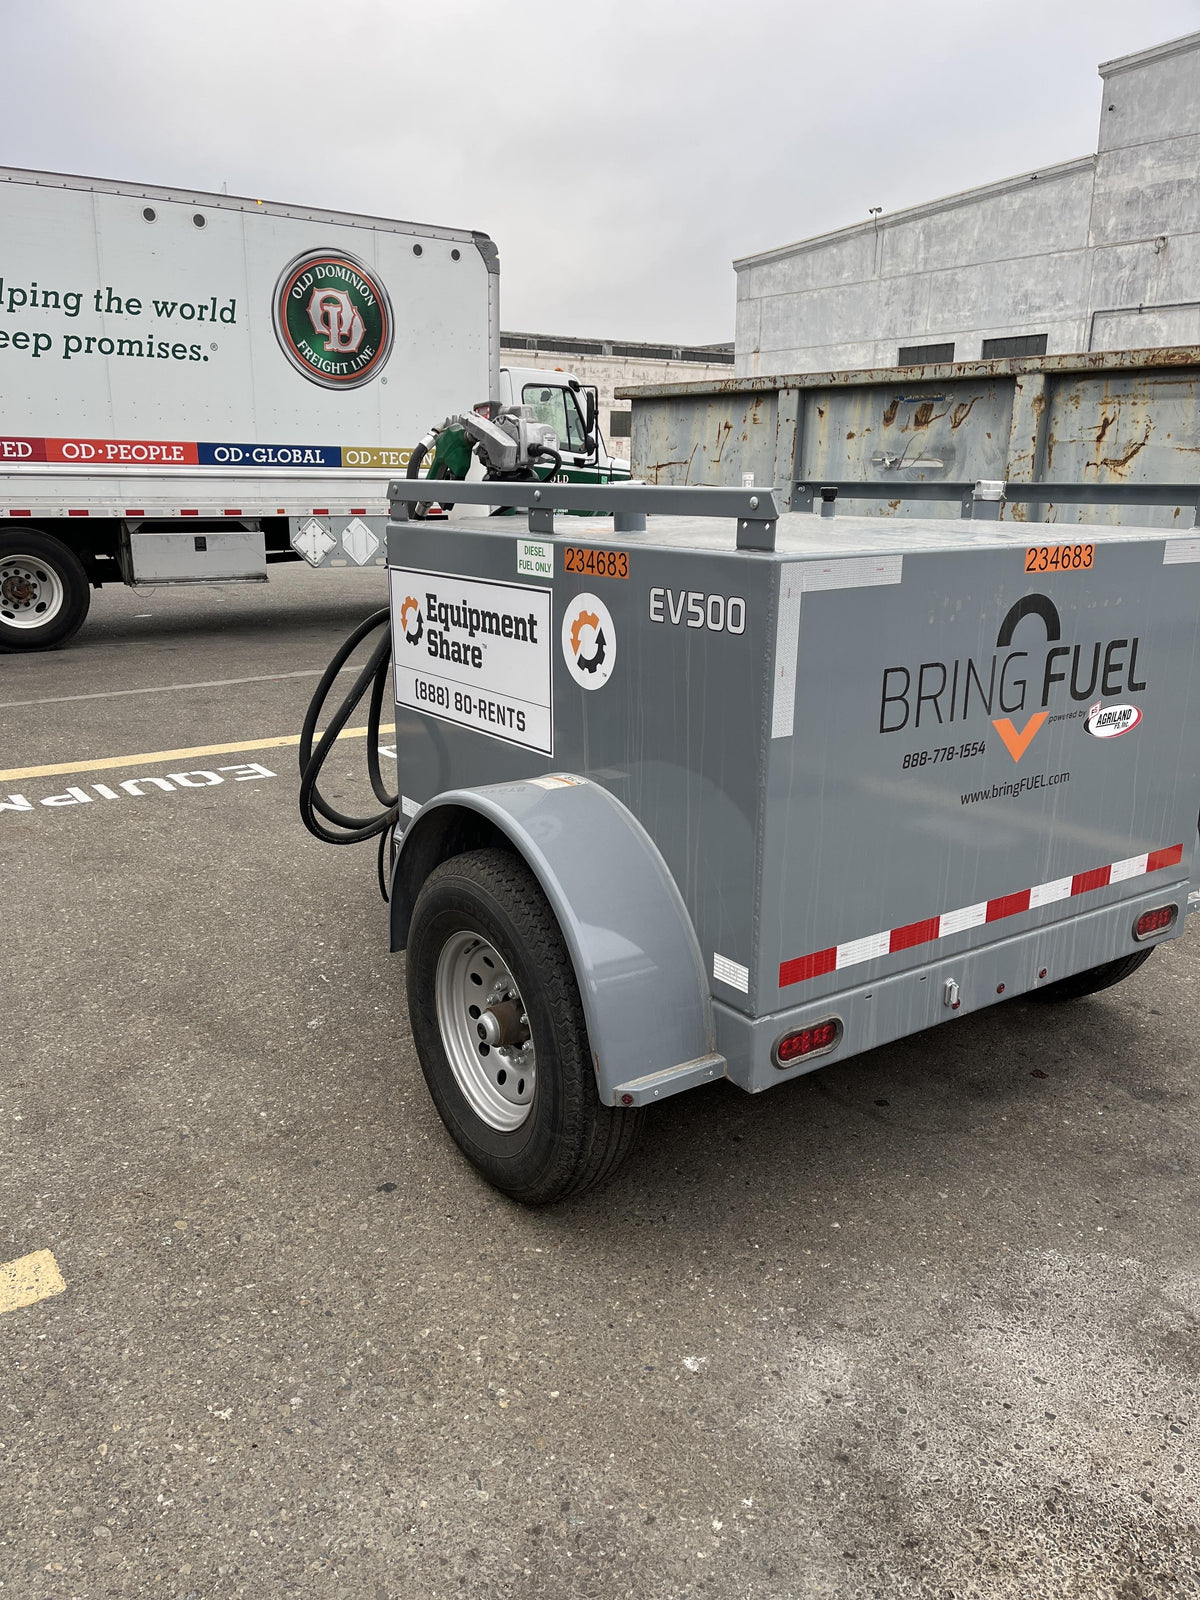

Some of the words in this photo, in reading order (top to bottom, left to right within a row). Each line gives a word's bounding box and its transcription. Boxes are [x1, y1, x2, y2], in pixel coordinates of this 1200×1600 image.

[292, 273, 313, 299] OLD
[315, 265, 376, 306] DOMINION
[94, 286, 142, 315] the
[152, 297, 237, 324] world
[297, 339, 348, 374] FREIGHT
[351, 345, 376, 371] LINE
[0, 441, 33, 457] ED
[519, 559, 534, 571] FUEL
[535, 561, 551, 574] ONLY
[524, 545, 546, 558] DIESEL
[566, 548, 629, 577] 234683
[1026, 544, 1093, 572] 234683
[425, 593, 537, 644] Equipment
[649, 586, 746, 635] EV500
[879, 652, 1028, 733] BRING
[1041, 637, 1147, 707] FUEL
[415, 678, 449, 709] (888)
[454, 692, 526, 732] 80-RENTS
[1048, 711, 1077, 724] powered
[1078, 710, 1087, 719] by
[1097, 709, 1132, 725] AGRILAND
[902, 740, 986, 769] 888-778-1554
[960, 771, 1070, 805] www.bringFUEL.com
